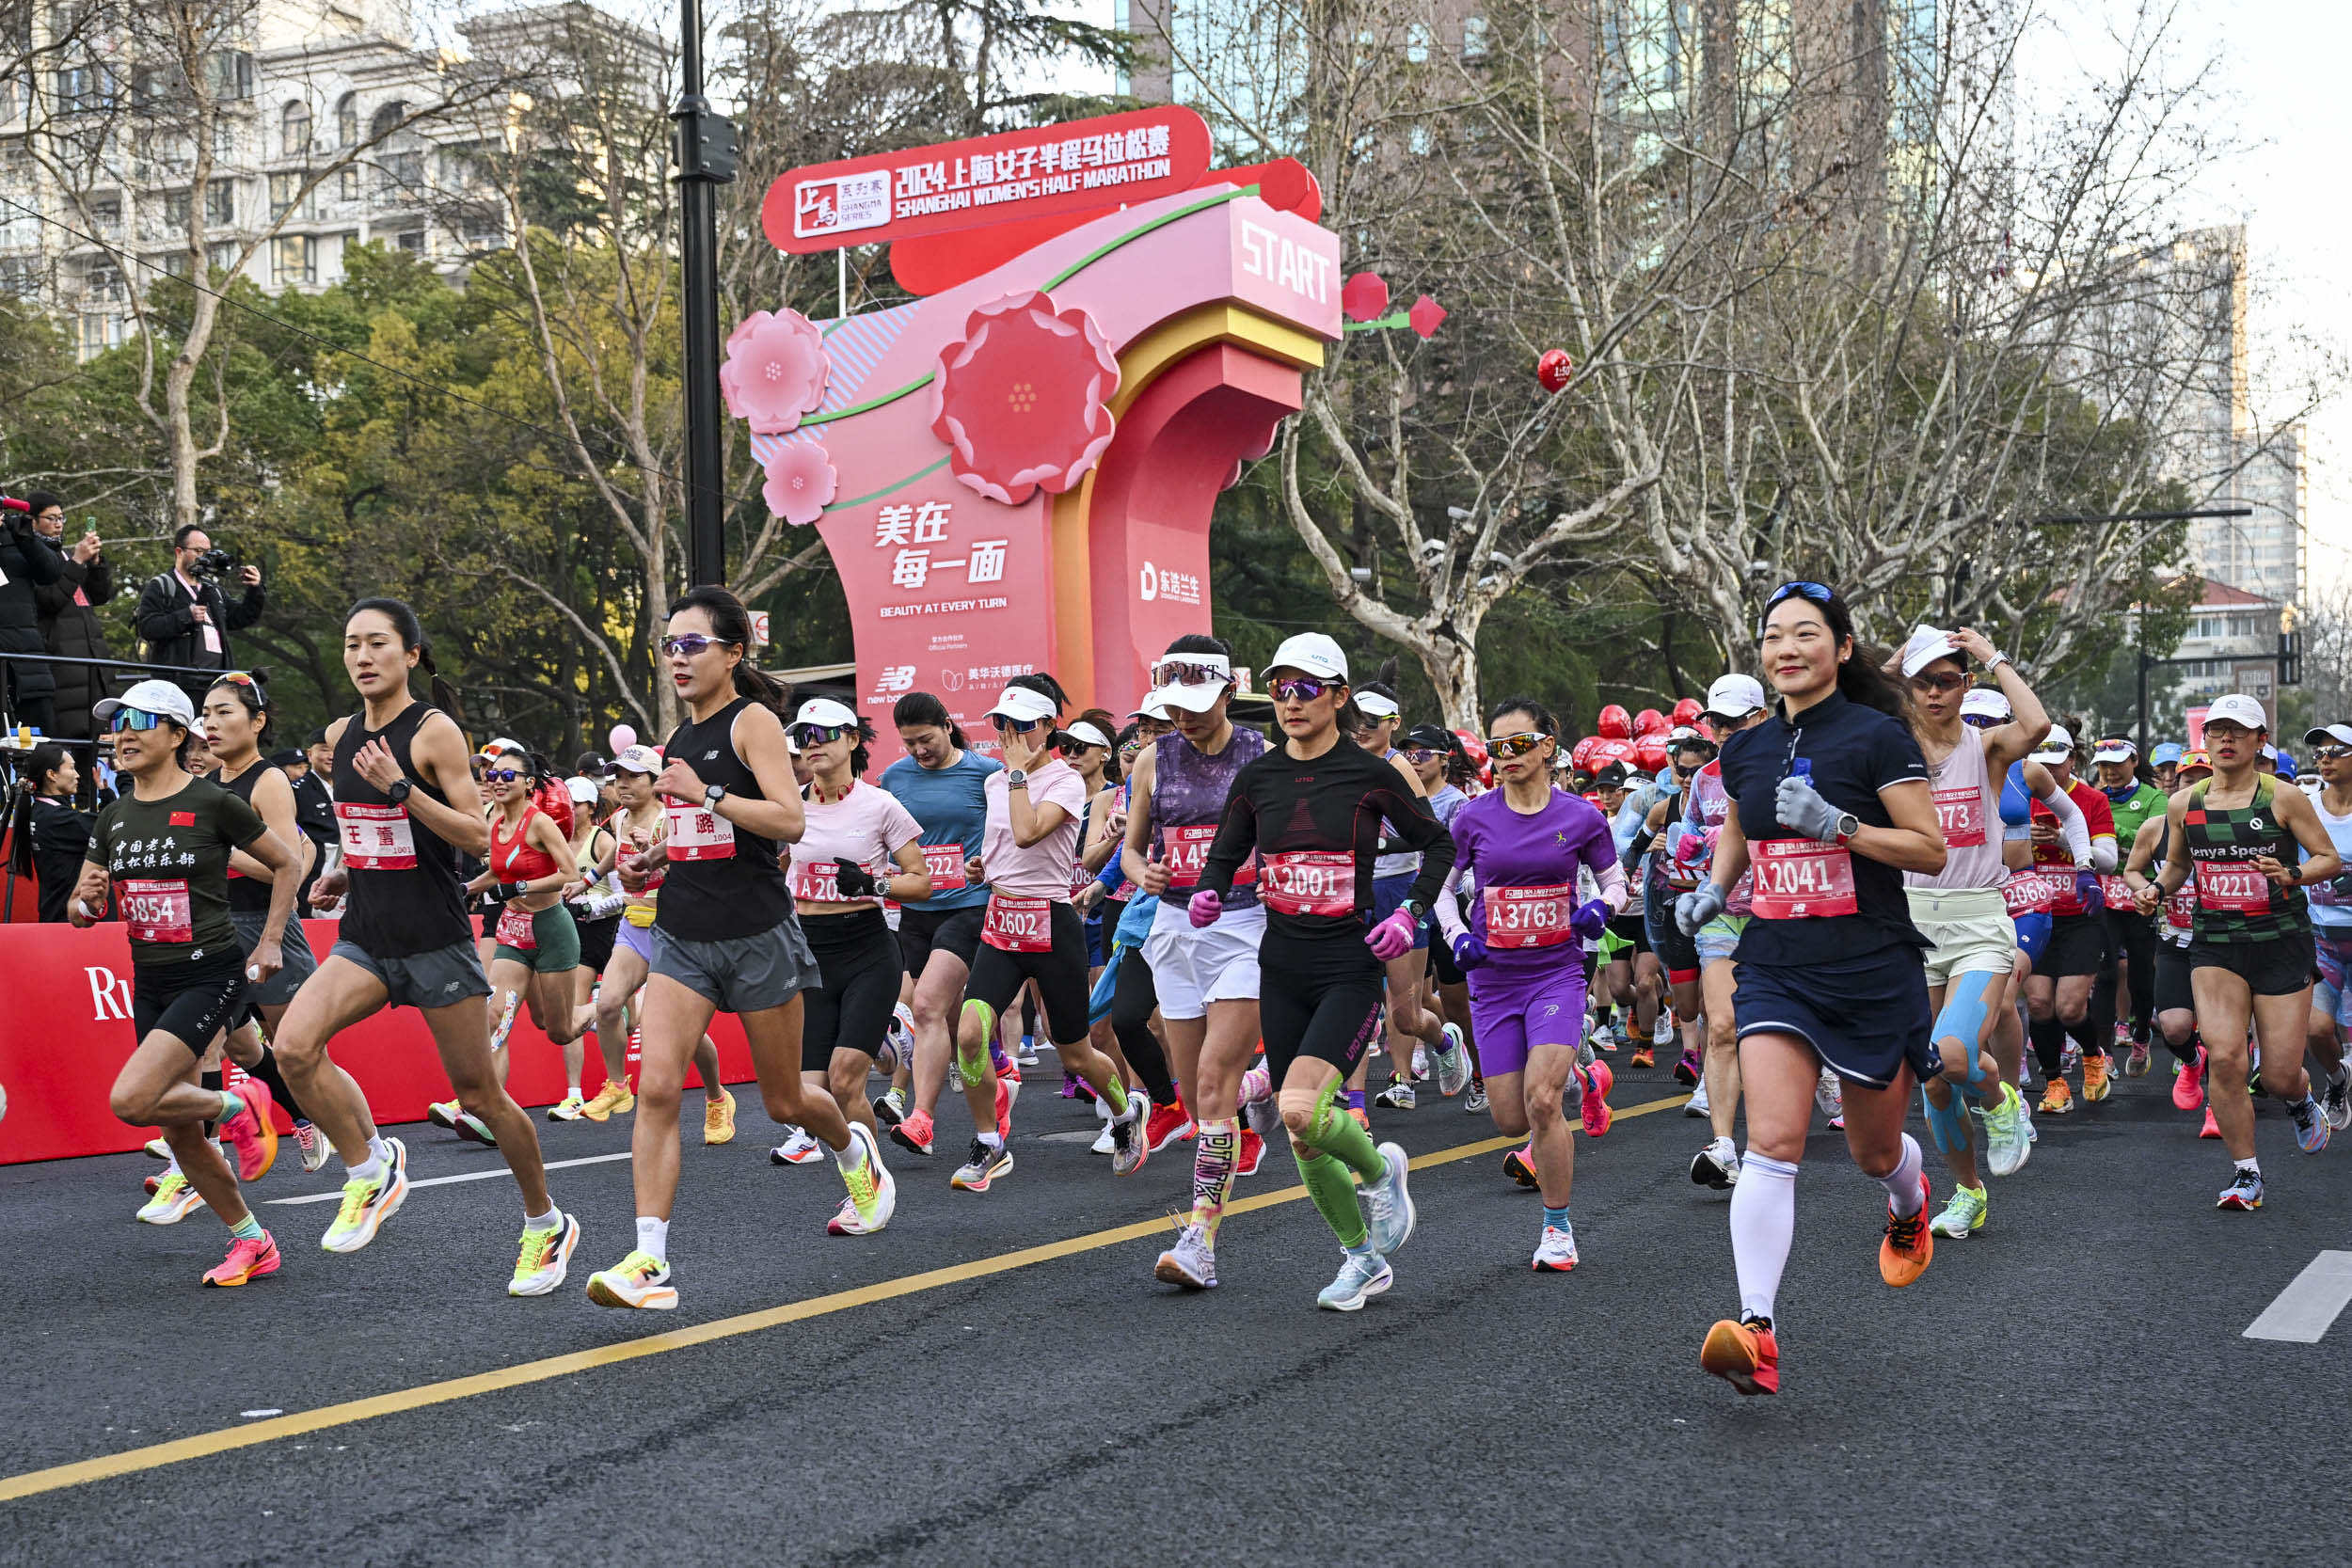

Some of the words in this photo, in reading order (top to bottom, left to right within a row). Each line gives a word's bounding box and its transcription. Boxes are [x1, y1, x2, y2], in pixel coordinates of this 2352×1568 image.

[896, 125, 1169, 198] 2024上海女子半程马拉松赛
[896, 190, 970, 219] SHANGHAI
[974, 180, 1041, 206] WOMEN'S
[1042, 176, 1081, 196] HALF
[1084, 159, 1170, 189] MARATHON
[1241, 223, 1330, 306] START
[875, 500, 952, 547] 美在
[892, 539, 1009, 589] 每一面
[1160, 569, 1200, 598] 东浩兰生
[881, 605, 922, 618] BEAUTY
[925, 603, 939, 614] AT
[941, 599, 976, 613] EVERY
[977, 596, 1007, 610] TURN
[968, 664, 1033, 681] 美华沃德医疗
[867, 696, 886, 705] new
[116, 836, 176, 856] 中国老兵
[713, 833, 732, 842] 1004
[109, 852, 196, 873] 拉松俱乐部
[2231, 843, 2277, 859] Speed
[1193, 1132, 1233, 1205] PINK
